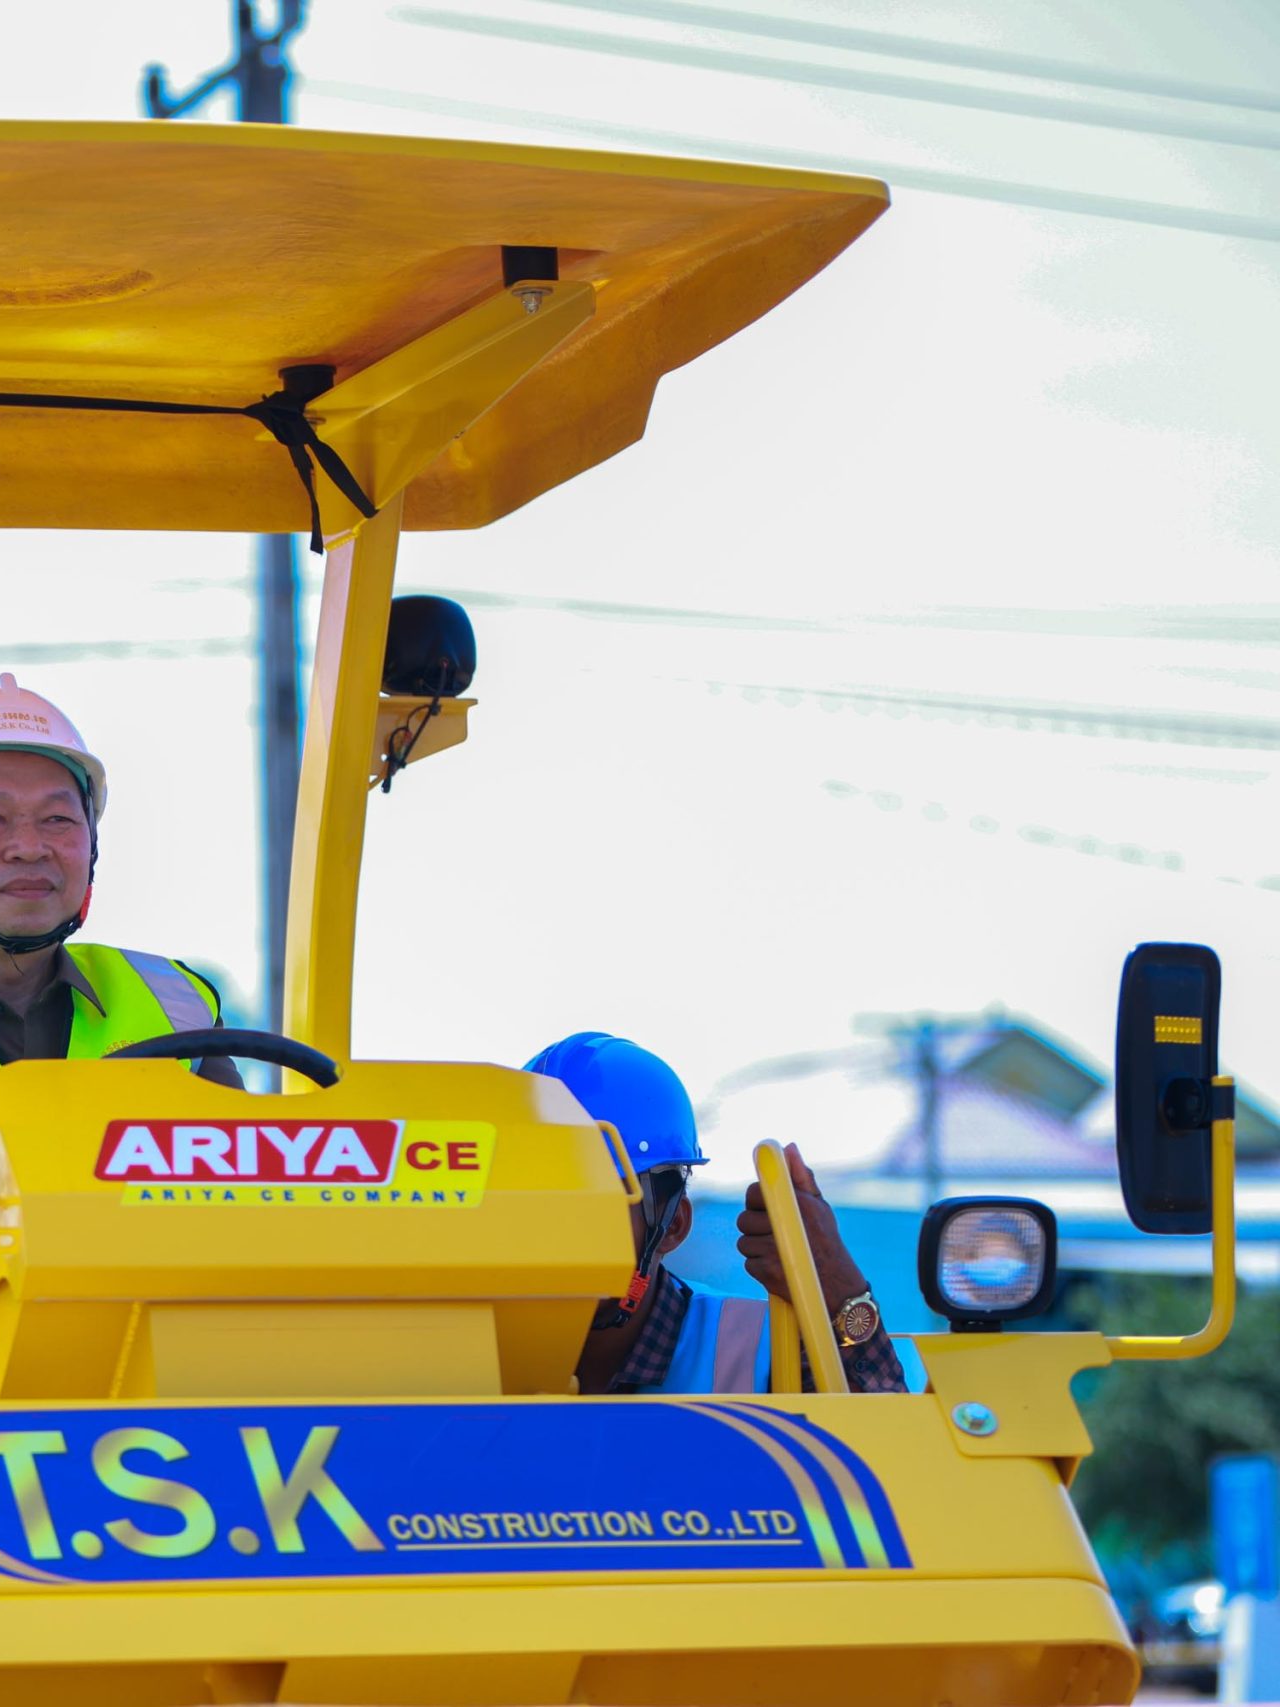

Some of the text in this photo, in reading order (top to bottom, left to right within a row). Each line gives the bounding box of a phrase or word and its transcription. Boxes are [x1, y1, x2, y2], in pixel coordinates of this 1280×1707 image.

[104, 1125, 481, 1177] ARIYA CE
[140, 1188, 469, 1204] ARIYA CE COMPANY
[387, 1510, 654, 1544] CONSTRUCTION
[660, 1508, 799, 1542] CO.,LTD
